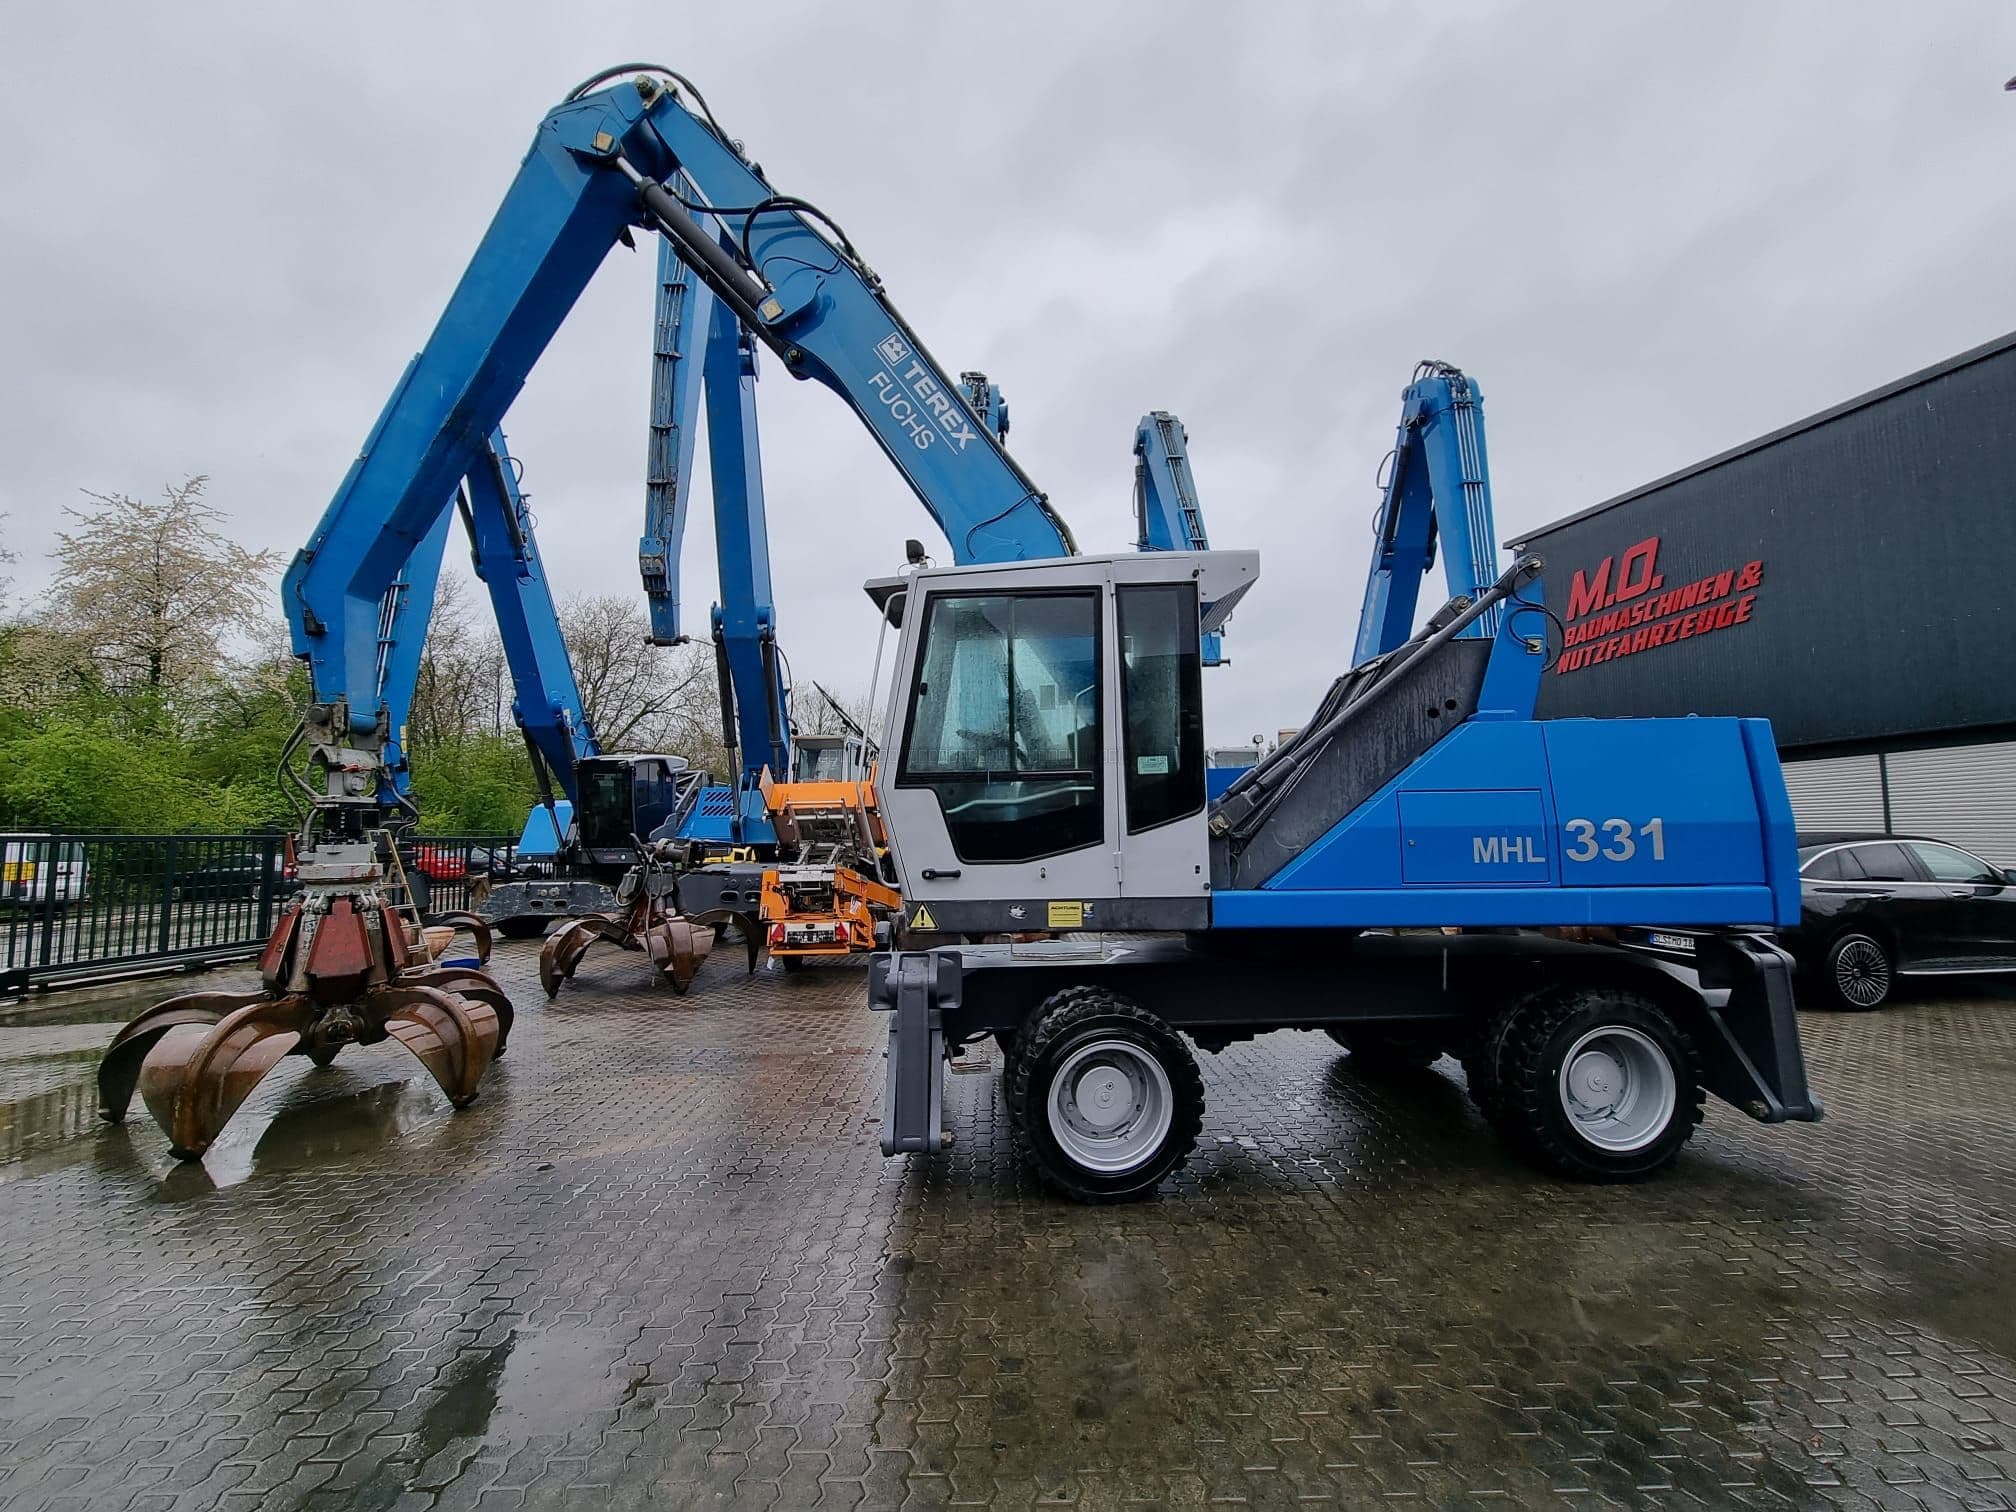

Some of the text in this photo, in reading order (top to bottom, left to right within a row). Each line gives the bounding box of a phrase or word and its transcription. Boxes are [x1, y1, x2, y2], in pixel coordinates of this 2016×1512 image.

[868, 371, 935, 450] FUCHS
[904, 360, 978, 450] TEREX
[1563, 560, 1763, 648] BAUMASCHINEN &
[1566, 537, 1664, 621] M.O.
[1556, 594, 1757, 675] NUTZFAHRZEUGE
[1472, 817, 1665, 864] MHL 331
